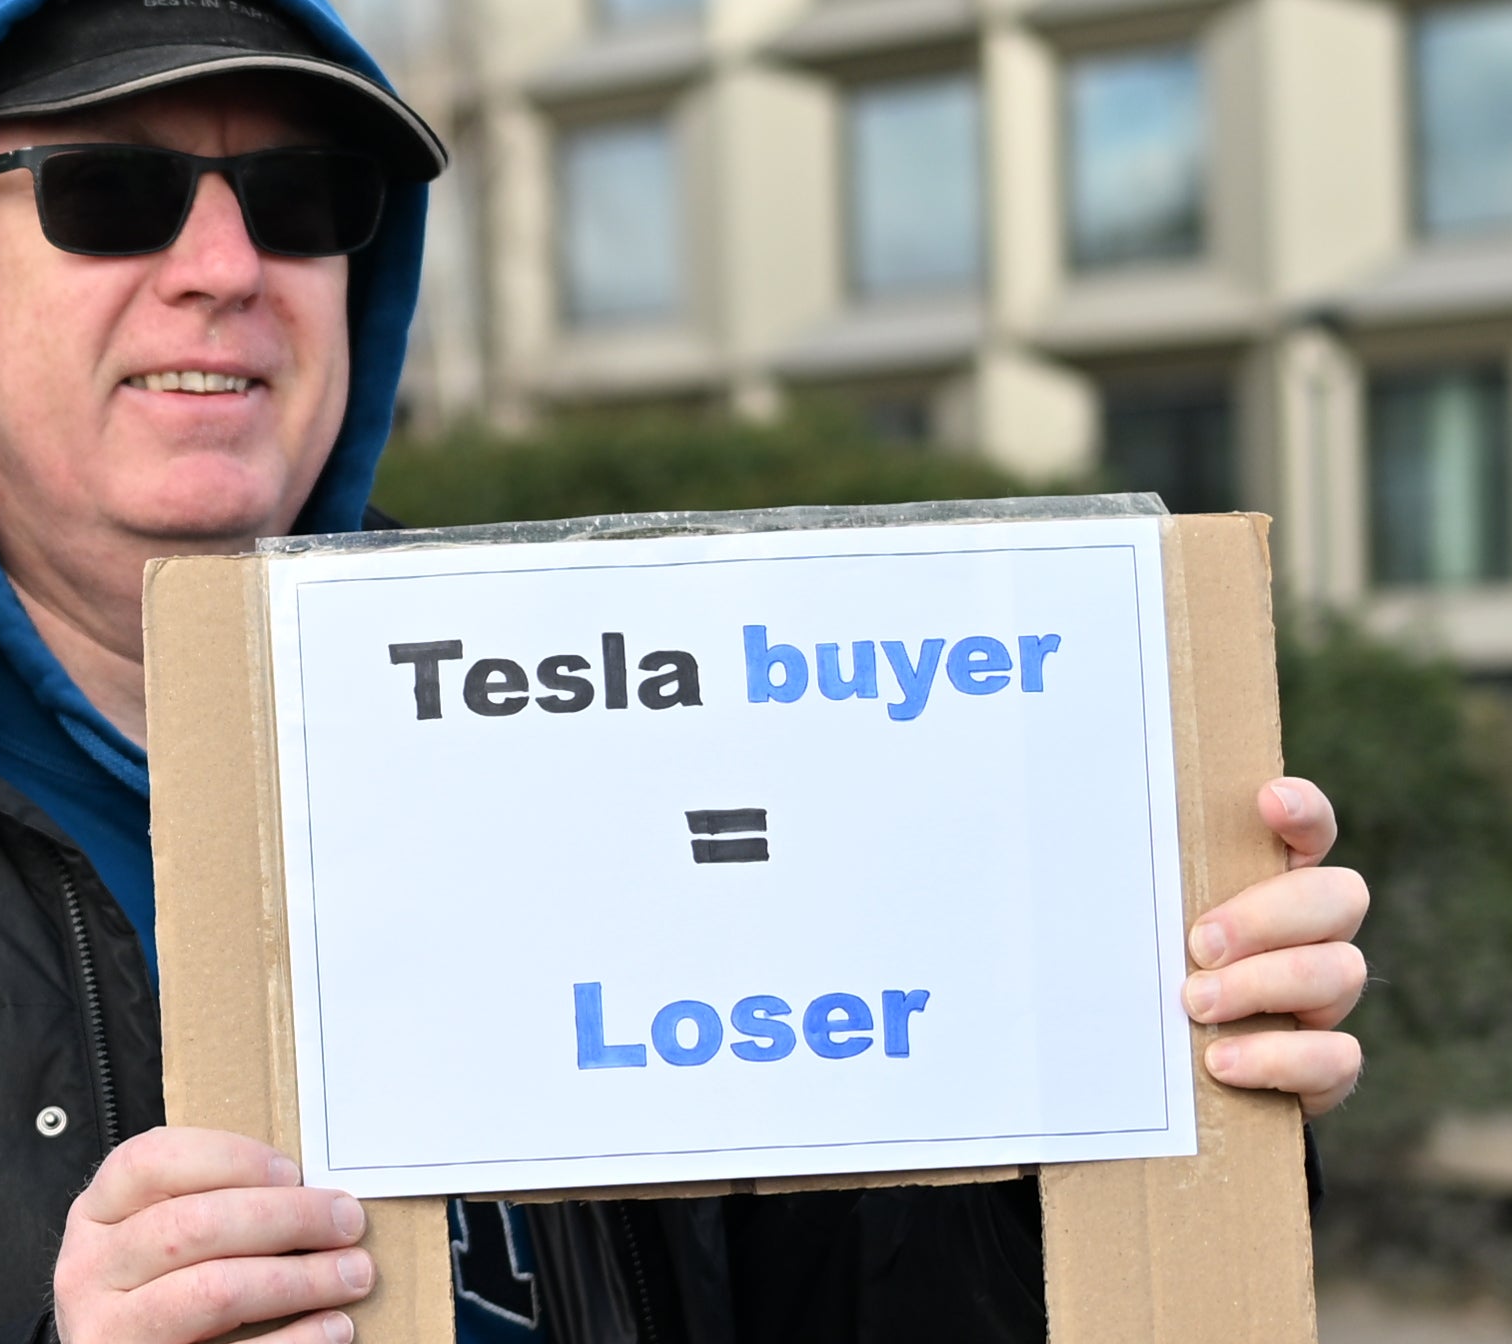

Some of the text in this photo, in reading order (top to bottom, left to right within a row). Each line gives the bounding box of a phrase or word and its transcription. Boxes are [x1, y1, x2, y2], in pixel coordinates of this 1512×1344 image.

[389, 625, 1061, 721] Tesla buyer
[685, 808, 769, 864] =
[574, 982, 930, 1069] Loser
